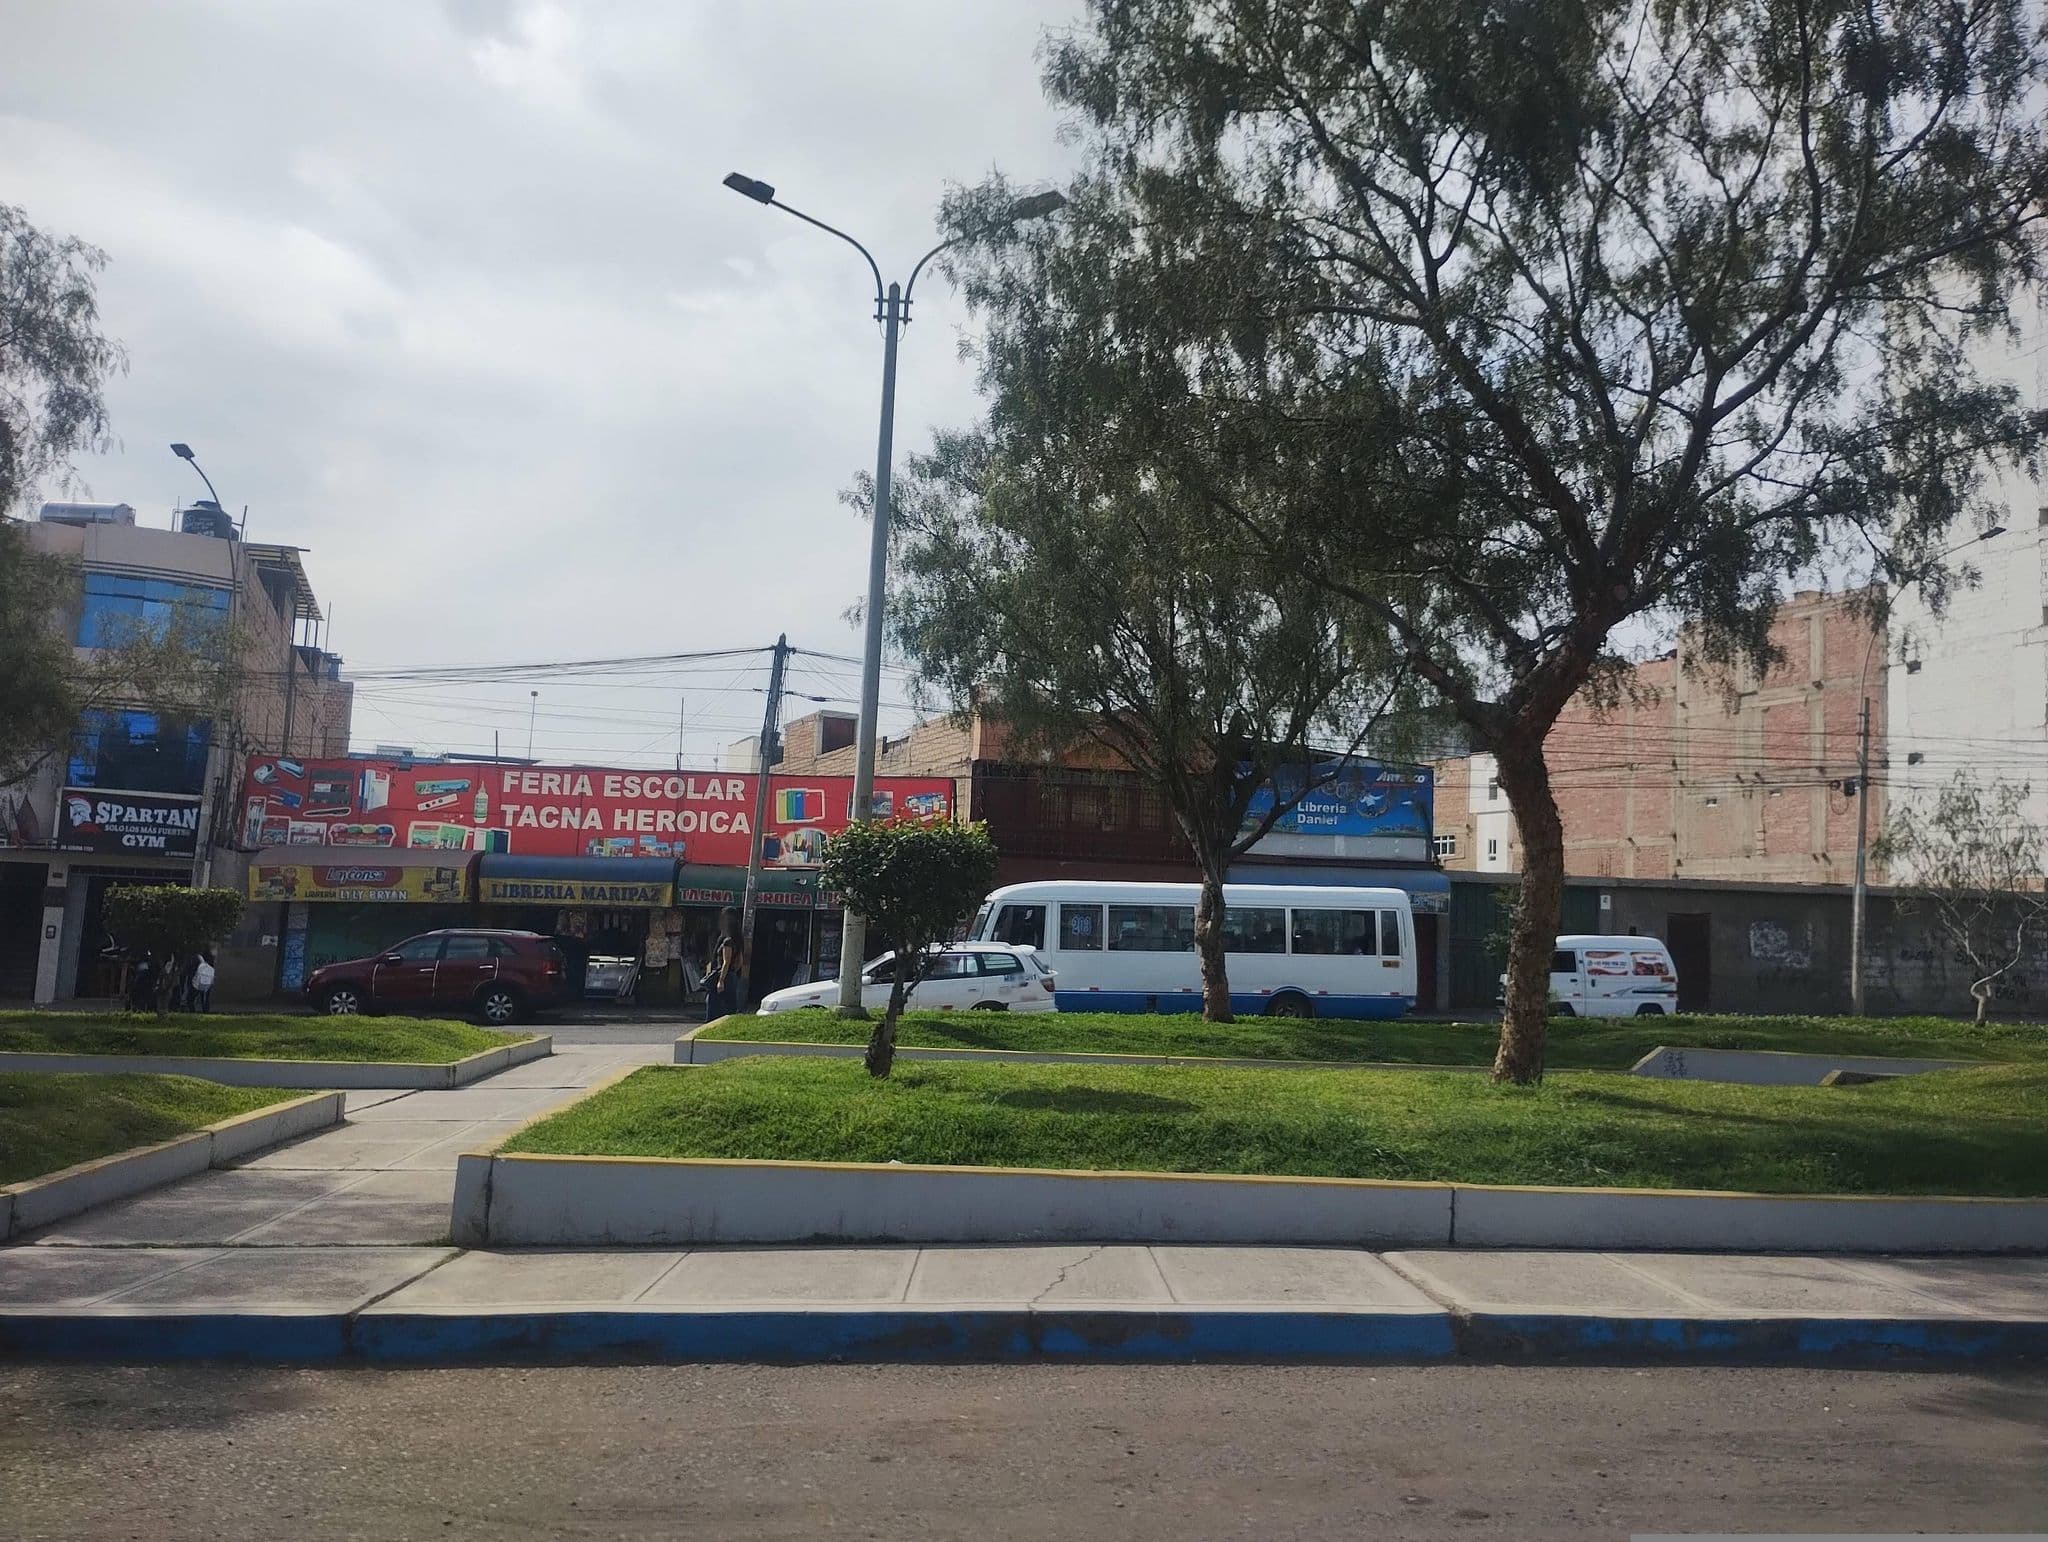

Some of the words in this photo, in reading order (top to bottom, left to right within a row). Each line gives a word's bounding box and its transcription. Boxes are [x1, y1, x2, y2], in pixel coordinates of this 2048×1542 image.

[503, 771, 593, 796] FERIA
[604, 776, 745, 801] ESCOLAR
[95, 801, 199, 829] SPARTAN
[500, 804, 603, 830] TACNA
[613, 809, 751, 834] HEROICA
[1297, 814, 1338, 825] Daniel
[104, 824, 125, 832] SOLO
[126, 825, 139, 833] LOS
[121, 834, 167, 848] GYM
[491, 883, 575, 900] LIBRERIA
[681, 889, 734, 902] TACNA
